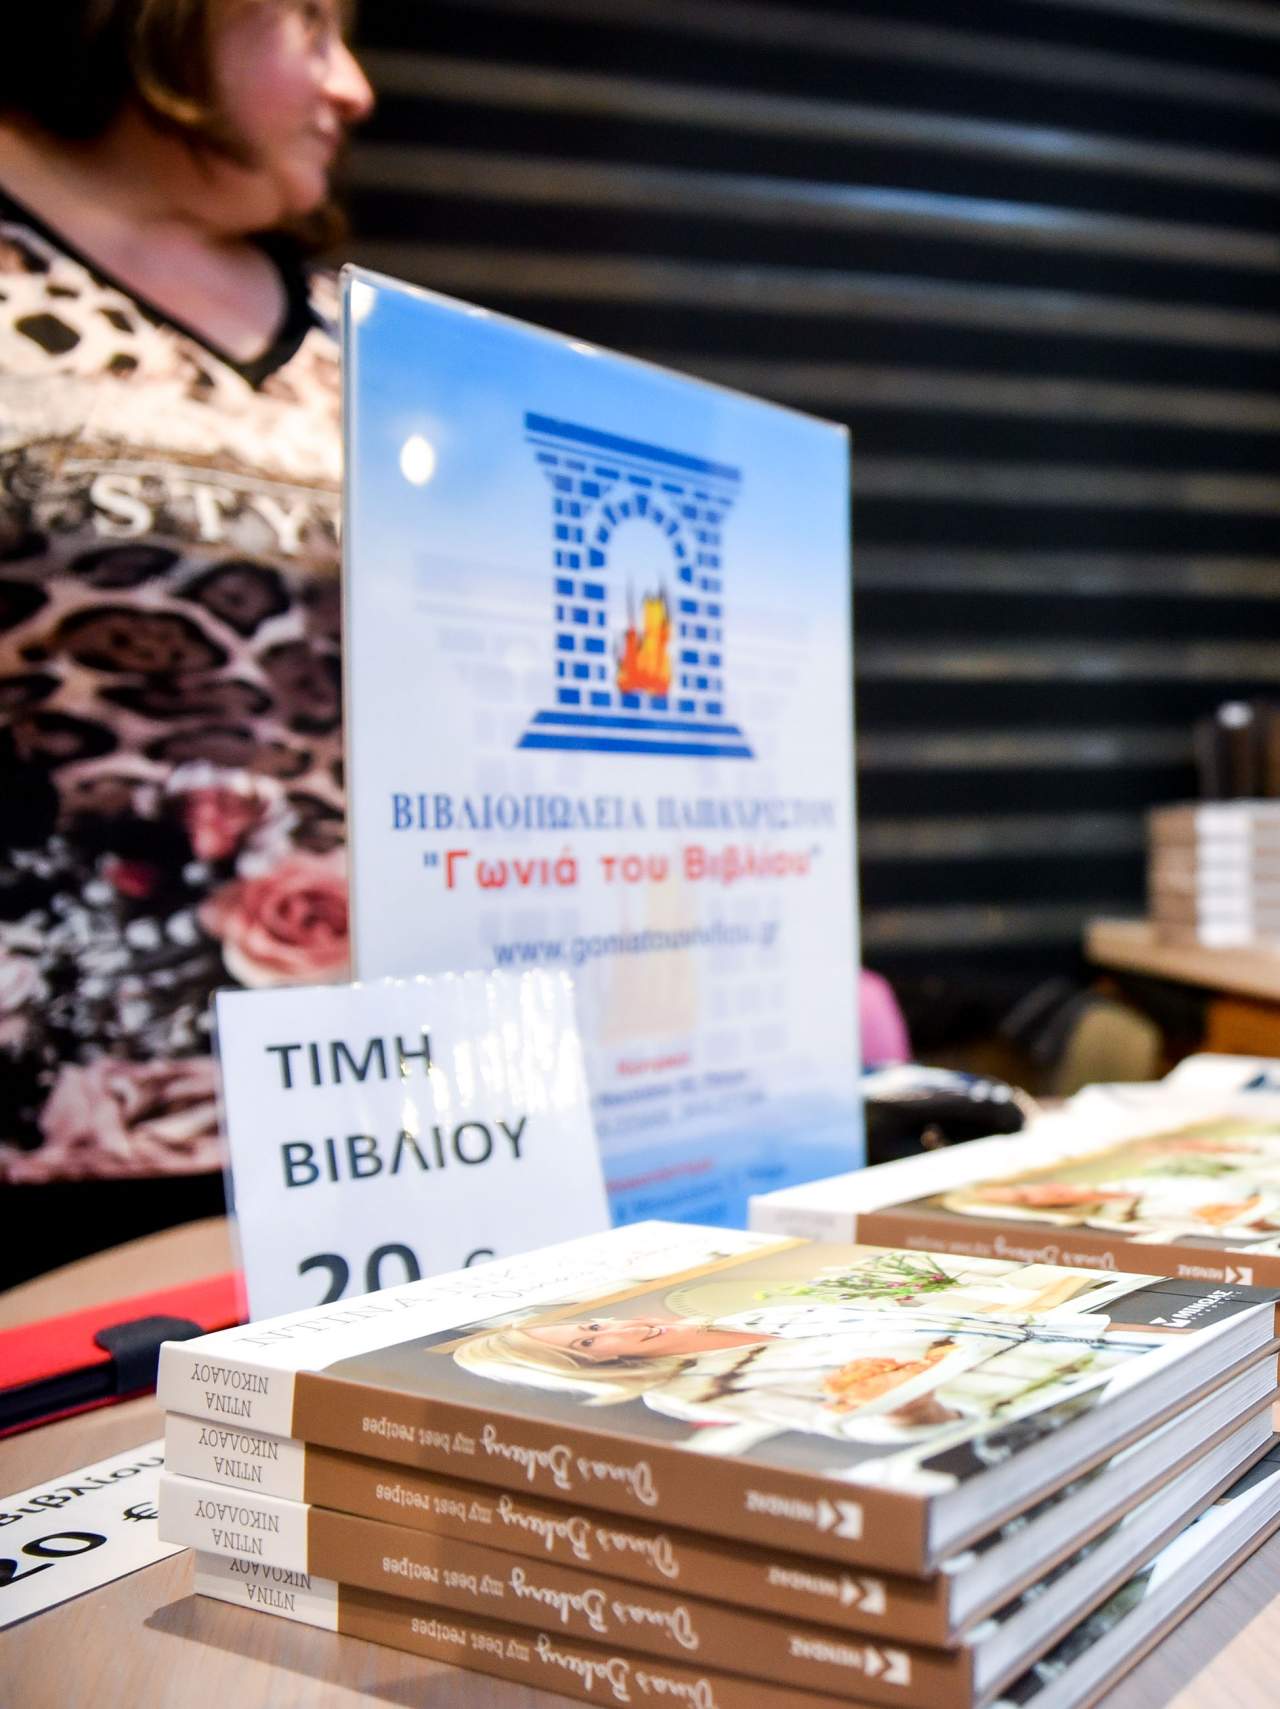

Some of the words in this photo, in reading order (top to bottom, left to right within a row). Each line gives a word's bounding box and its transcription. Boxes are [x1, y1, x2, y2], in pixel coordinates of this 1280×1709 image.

[390, 793, 647, 831] ΒΙΒΛΙΟΠΩΛΕΙΑ
[598, 854, 669, 881] του
[266, 1031, 433, 1090] ΤΙΜΗ
[281, 1115, 530, 1188] ΒΙΒΛΙΟΥ
[297, 1242, 422, 1306] 20
[191, 1362, 269, 1394] ΝΙΚΟΛΑΟΥ
[206, 1391, 252, 1418] ΝΤΙΝΑ
[362, 1416, 414, 1442] recipes
[419, 1428, 449, 1452] best
[198, 1427, 279, 1460] ΝΙΚΟΛΑΟΥ
[450, 1432, 477, 1454] my
[214, 1456, 263, 1484] ΝΤΙΝΑ
[375, 1483, 431, 1512] recipes
[434, 1497, 466, 1522] best
[122, 1502, 158, 1522] €
[195, 1499, 280, 1532] ΝΙΚΟΛΑΟΥ
[468, 1503, 492, 1524] my
[211, 1528, 264, 1555] ΝΤΙΝΑ
[382, 1556, 439, 1584] recipes
[443, 1570, 478, 1595] best
[247, 1583, 295, 1612] ΝΤΙΝΑ
[479, 1575, 504, 1597] my
[412, 1617, 467, 1645] recipes
[471, 1632, 503, 1659] best
[505, 1638, 530, 1662] my
